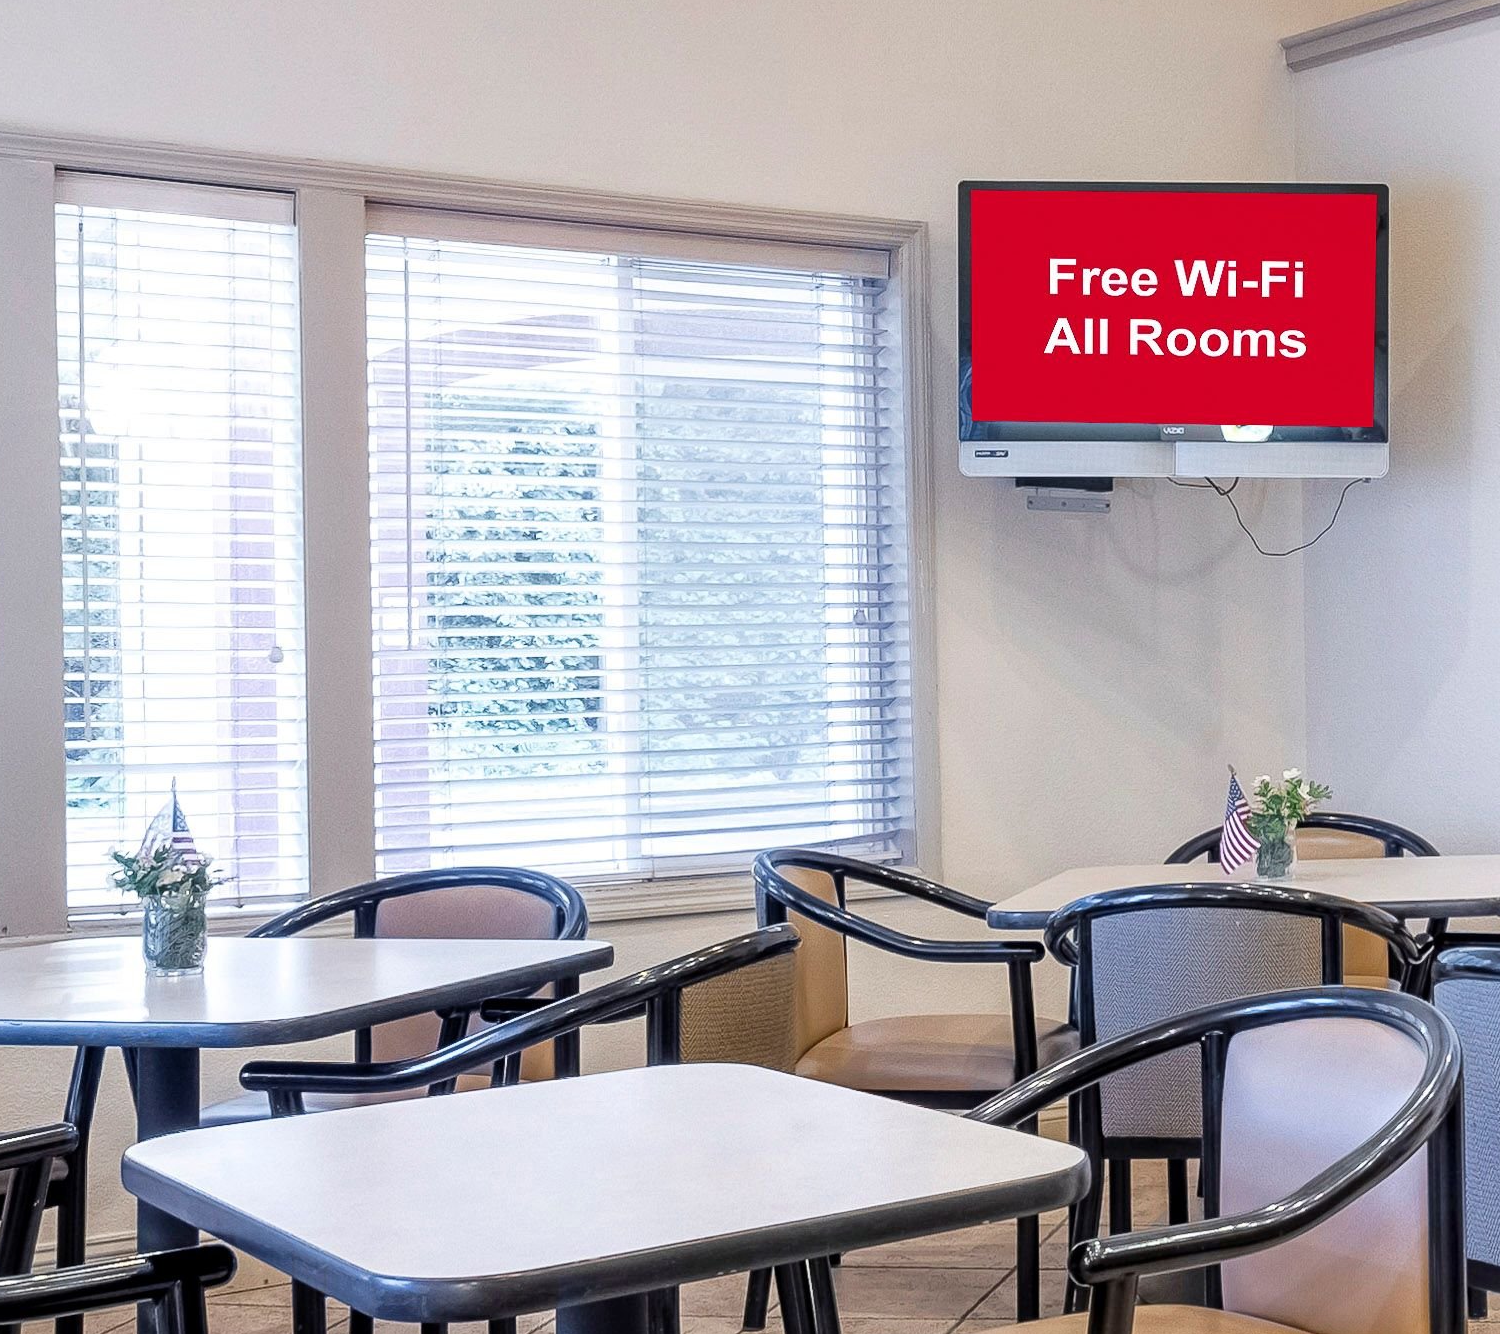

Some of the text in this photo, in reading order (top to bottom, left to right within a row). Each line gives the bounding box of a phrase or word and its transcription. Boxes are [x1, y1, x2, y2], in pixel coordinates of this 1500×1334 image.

[1049, 258, 1304, 298] Free Wi-Fi
[1043, 317, 1307, 359] All Rooms
